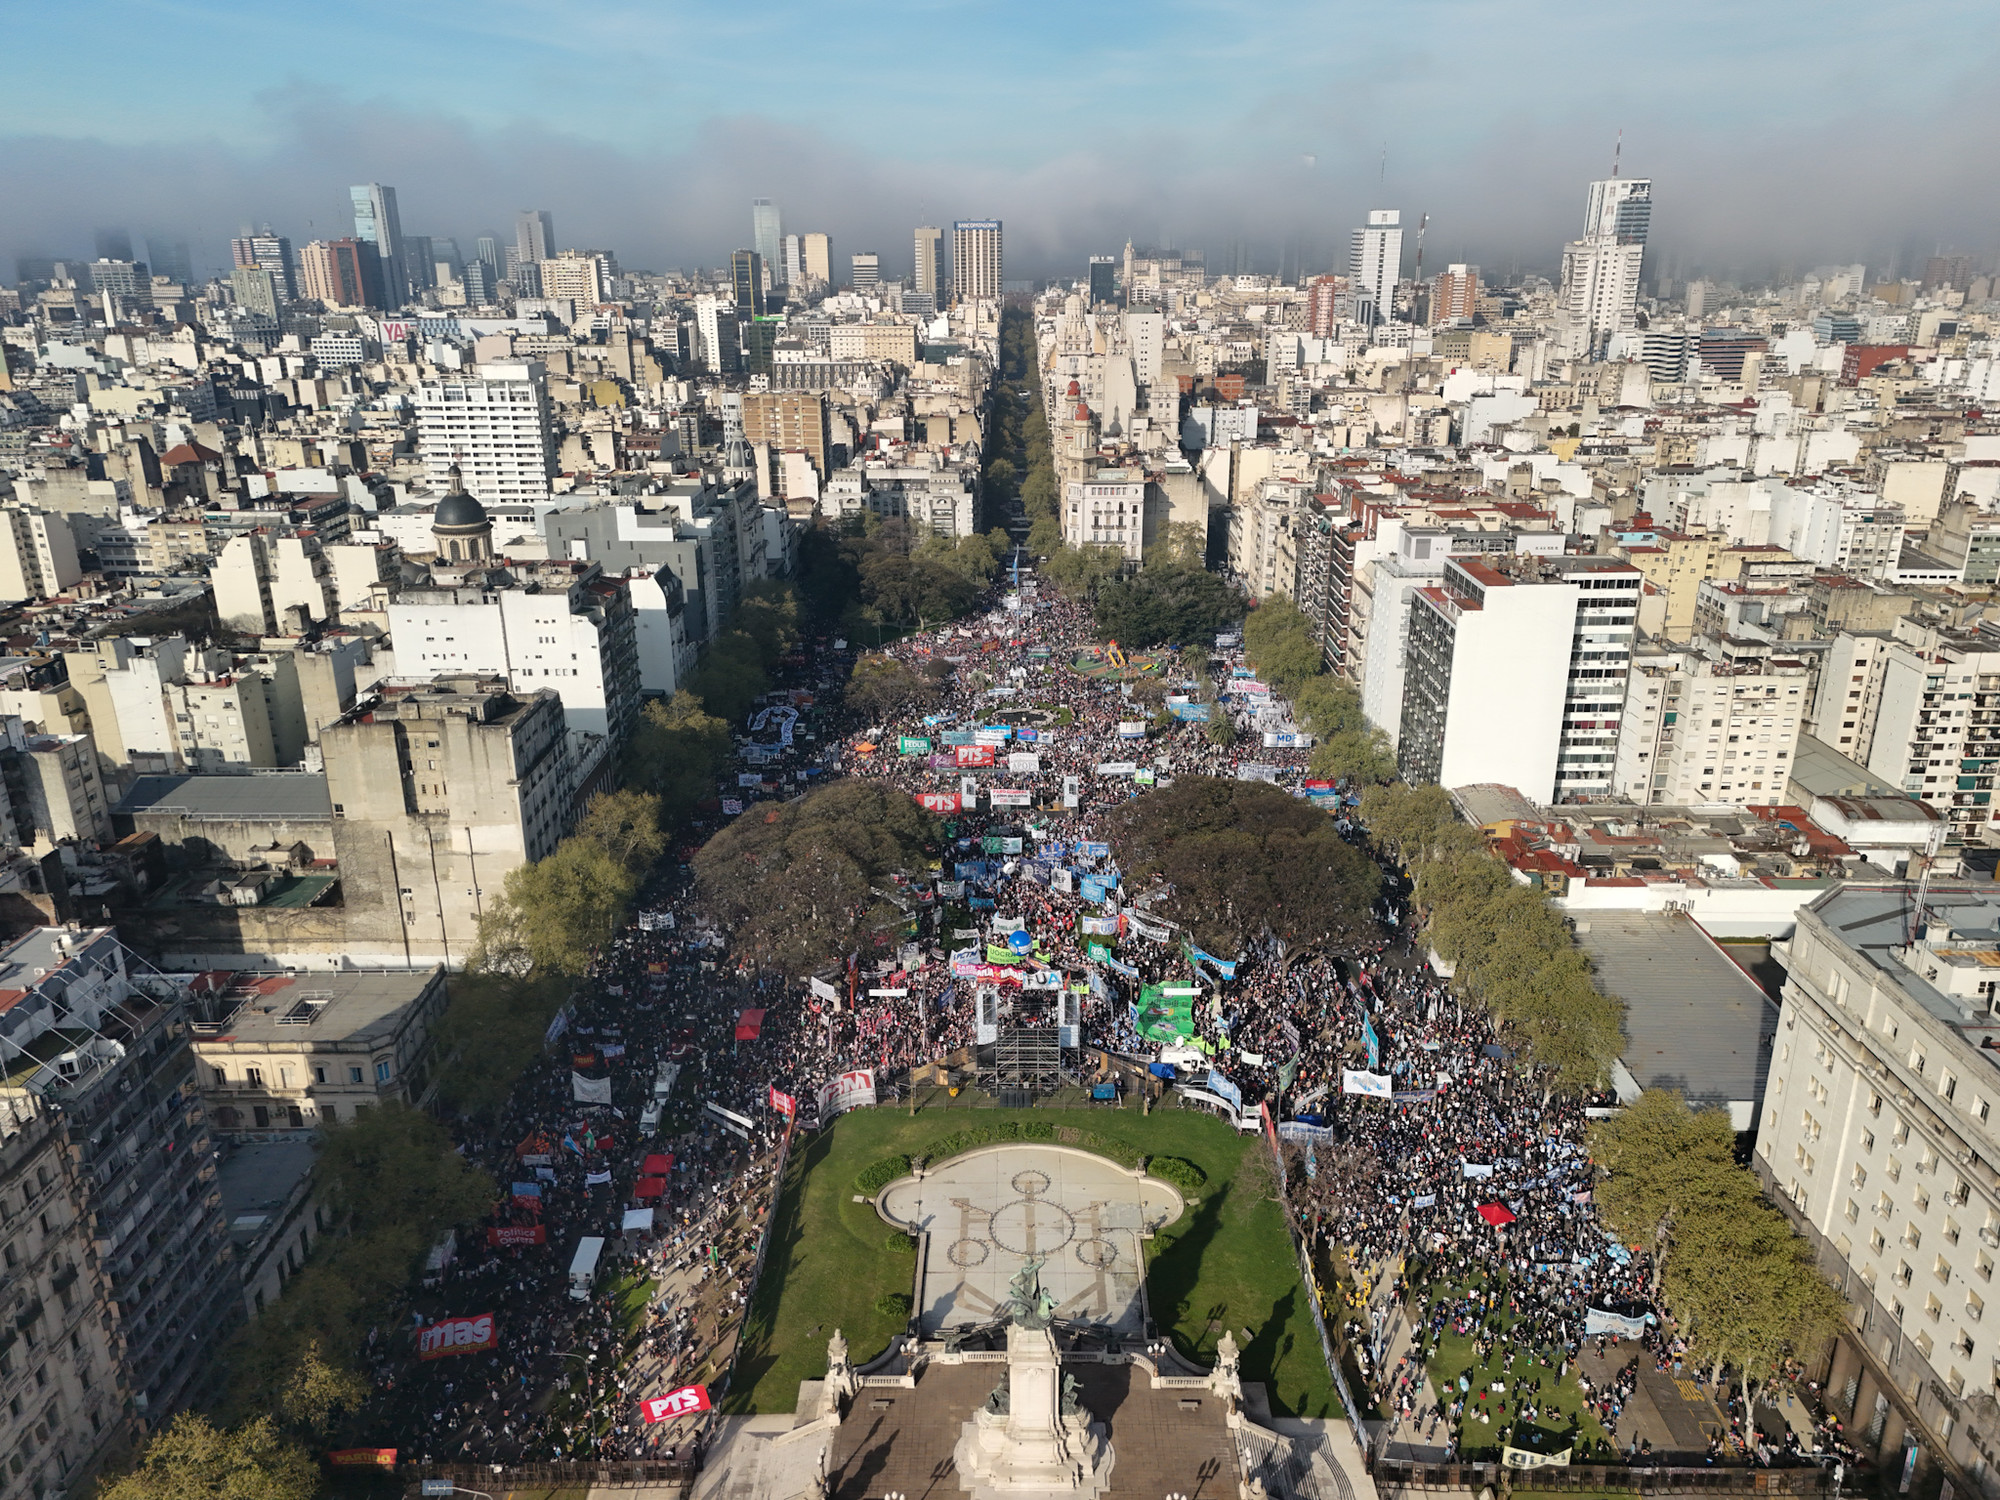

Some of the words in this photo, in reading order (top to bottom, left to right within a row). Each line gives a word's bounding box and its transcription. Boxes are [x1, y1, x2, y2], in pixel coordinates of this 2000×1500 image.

[958, 747, 983, 762] PTS
[924, 795, 956, 811] PTS
[496, 1228, 536, 1237] Política
[499, 1236, 535, 1245] Obrera
[427, 1317, 492, 1349] mas
[1673, 1379, 1705, 1402] BUS
[649, 1388, 700, 1418] PTS
[336, 1453, 391, 1462] PARTIDO
